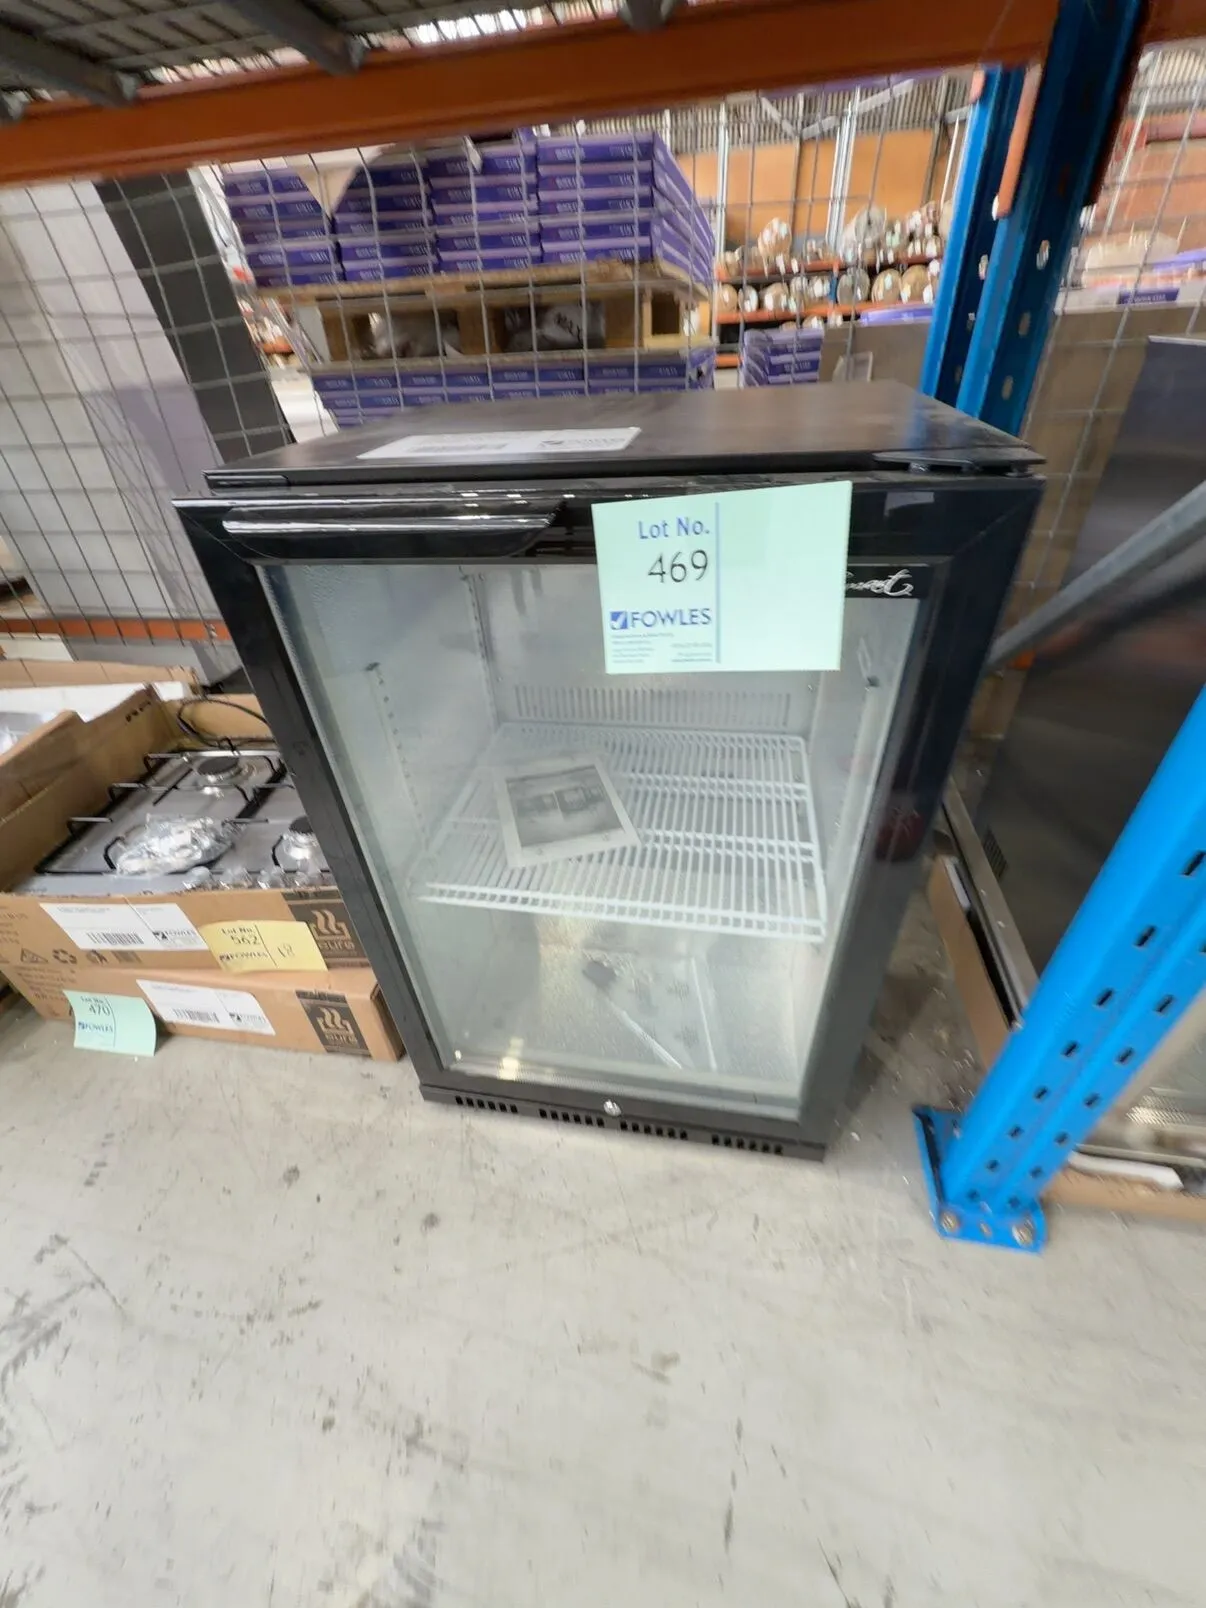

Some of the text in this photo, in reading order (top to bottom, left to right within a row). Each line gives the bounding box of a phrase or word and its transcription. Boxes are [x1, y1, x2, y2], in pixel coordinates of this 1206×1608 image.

[638, 516, 710, 540] Lot No.
[647, 549, 709, 583] 469
[630, 607, 712, 628] FOWLES
[230, 935, 260, 945] 562
[88, 1004, 111, 1017] 470
